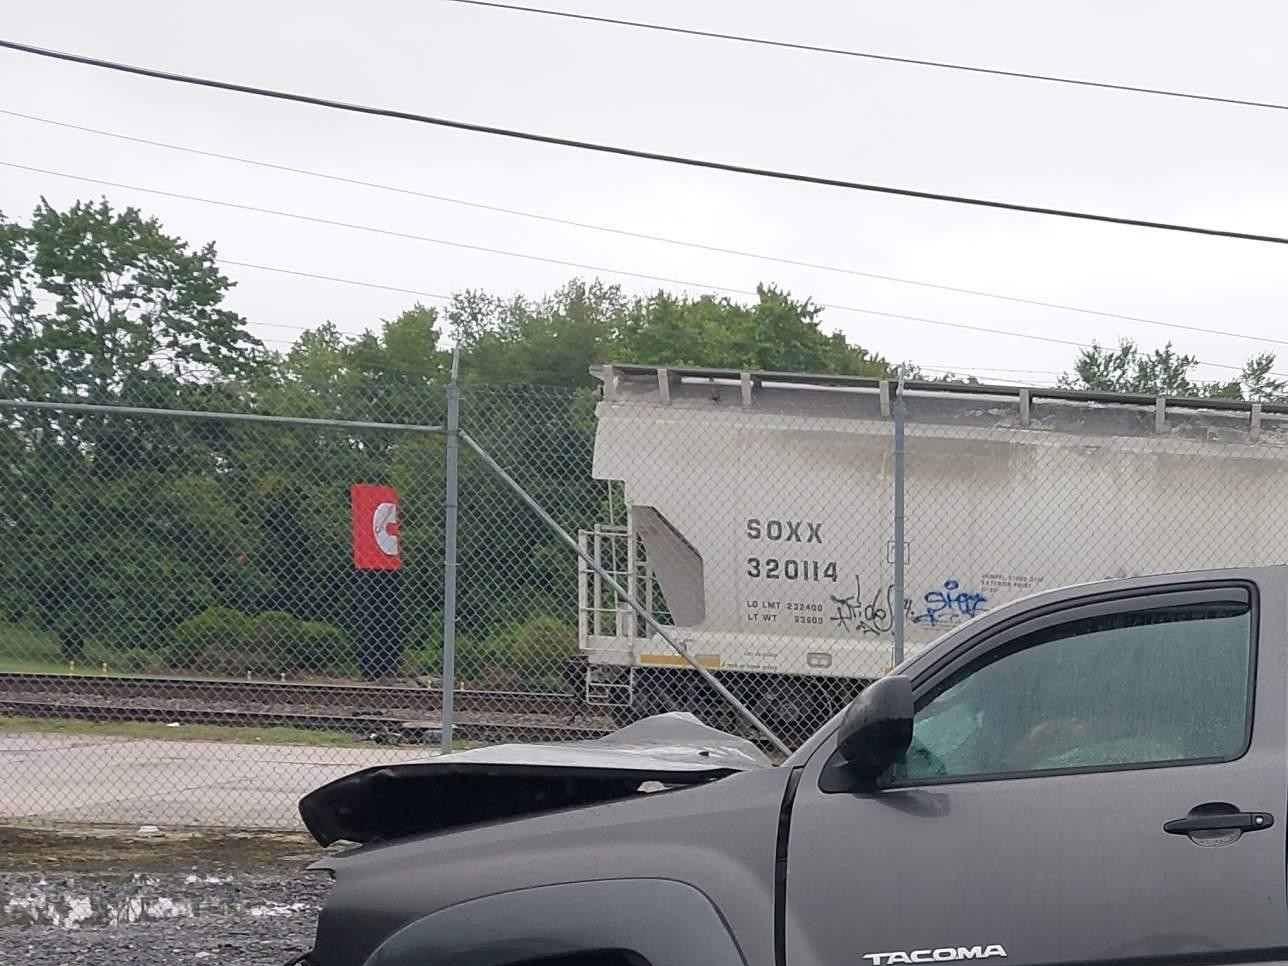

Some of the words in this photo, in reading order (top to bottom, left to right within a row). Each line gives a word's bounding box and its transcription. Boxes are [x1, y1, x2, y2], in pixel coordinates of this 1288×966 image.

[747, 519, 822, 543] SOXX
[747, 558, 838, 582] 320114
[762, 601, 780, 609] LMT
[747, 613, 758, 621] LT
[863, 944, 1008, 966] TACOMA
